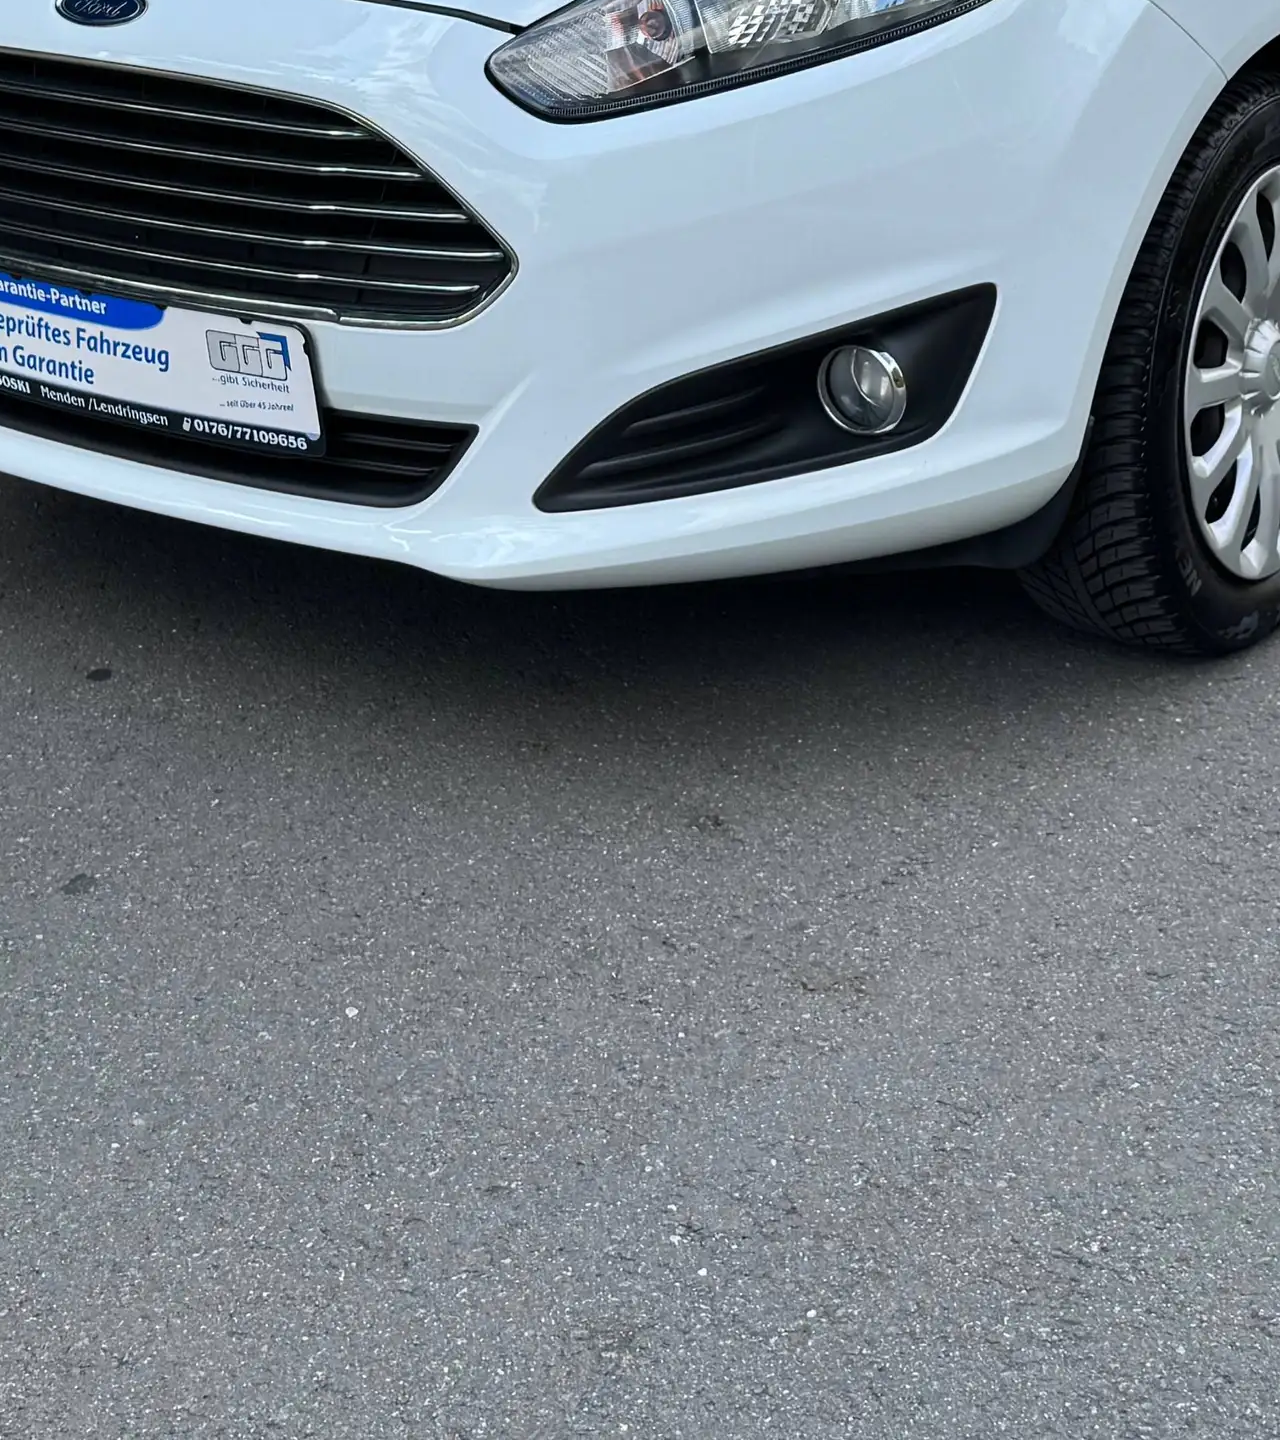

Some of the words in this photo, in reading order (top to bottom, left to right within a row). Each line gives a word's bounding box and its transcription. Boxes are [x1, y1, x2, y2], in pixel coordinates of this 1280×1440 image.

[13, 345, 95, 385] Garantie
[76, 328, 170, 373] Fahrzeug
[242, 376, 290, 394] Sicherheit
[40, 385, 85, 408] Menden
[194, 419, 308, 451] 0176/77109656
